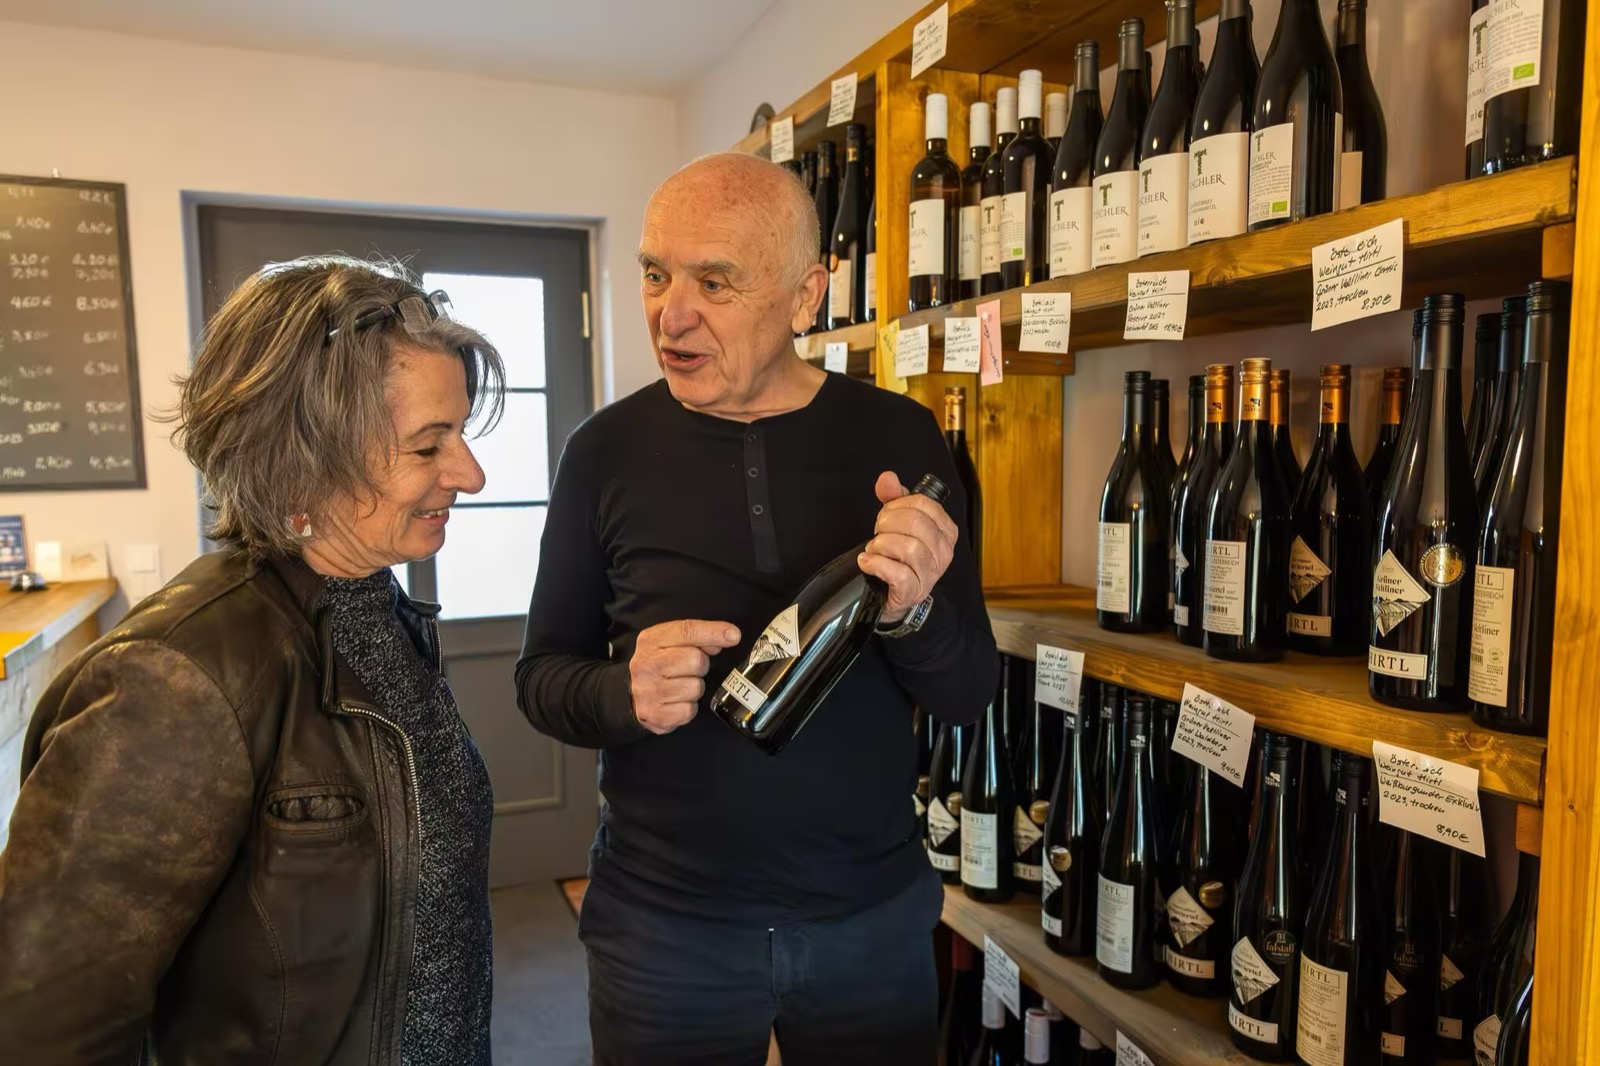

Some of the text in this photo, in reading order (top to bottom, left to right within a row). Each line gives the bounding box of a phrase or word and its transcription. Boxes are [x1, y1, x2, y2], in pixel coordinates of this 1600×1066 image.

[1319, 245, 1382, 278] Weingut Hirtl
[1361, 294, 1392, 310] 8,30€
[1183, 698, 1210, 718] Weingut
[1378, 758, 1443, 787] Weingut Hirtl
[1380, 775, 1480, 812] Weißburgunder Exklusiv
[1383, 790, 1445, 814] 2023, trocken
[1436, 824, 1470, 843] 8,90€
